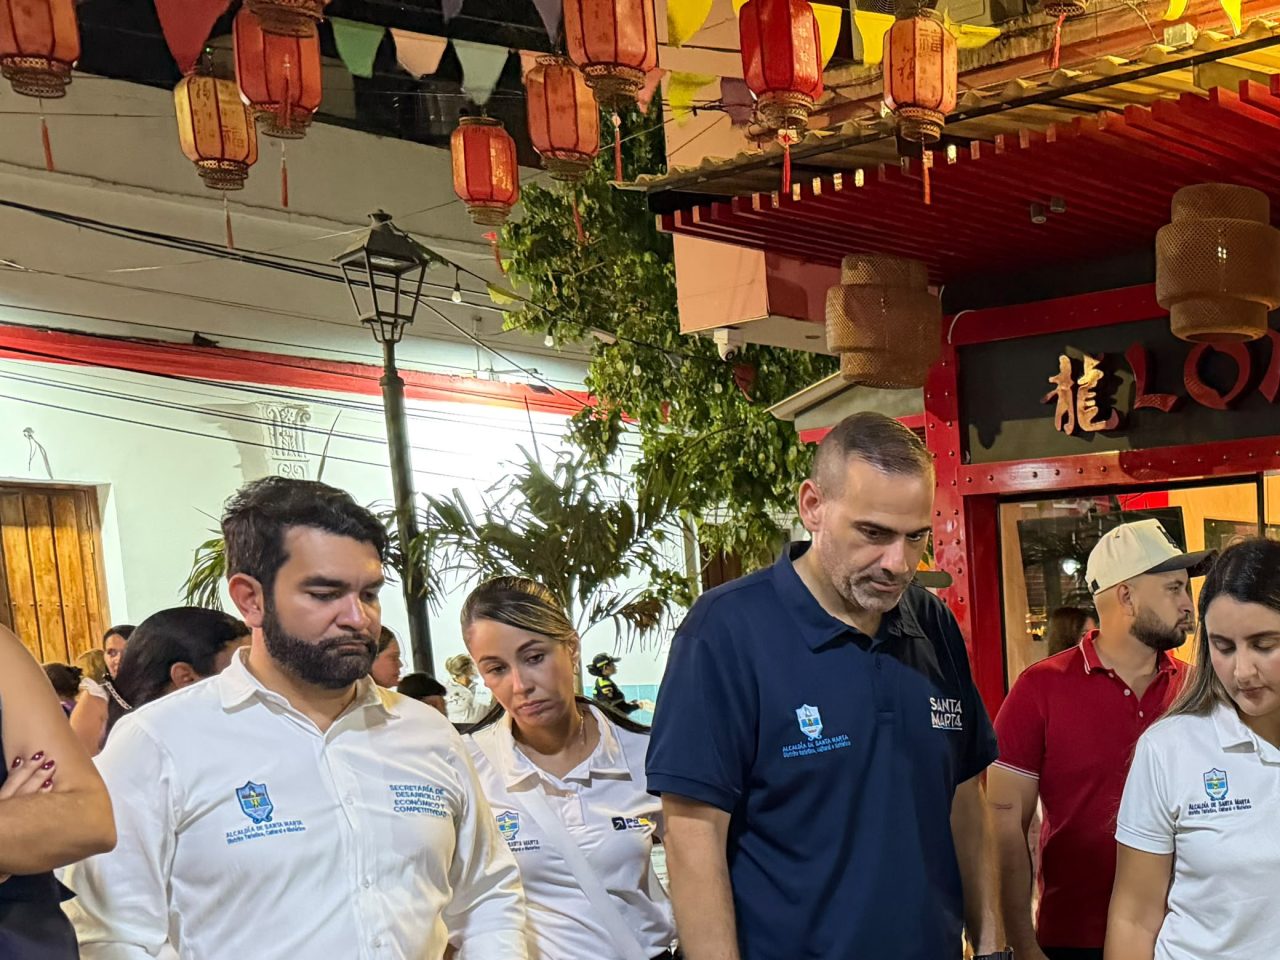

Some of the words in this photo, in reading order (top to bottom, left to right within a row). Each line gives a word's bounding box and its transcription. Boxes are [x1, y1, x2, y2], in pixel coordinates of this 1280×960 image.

[1040, 354, 1120, 436] 龍
[929, 696, 963, 714] SANTA
[930, 712, 963, 727] MARTA
[264, 821, 283, 830] SANTA
[283, 819, 304, 827] MARTA
